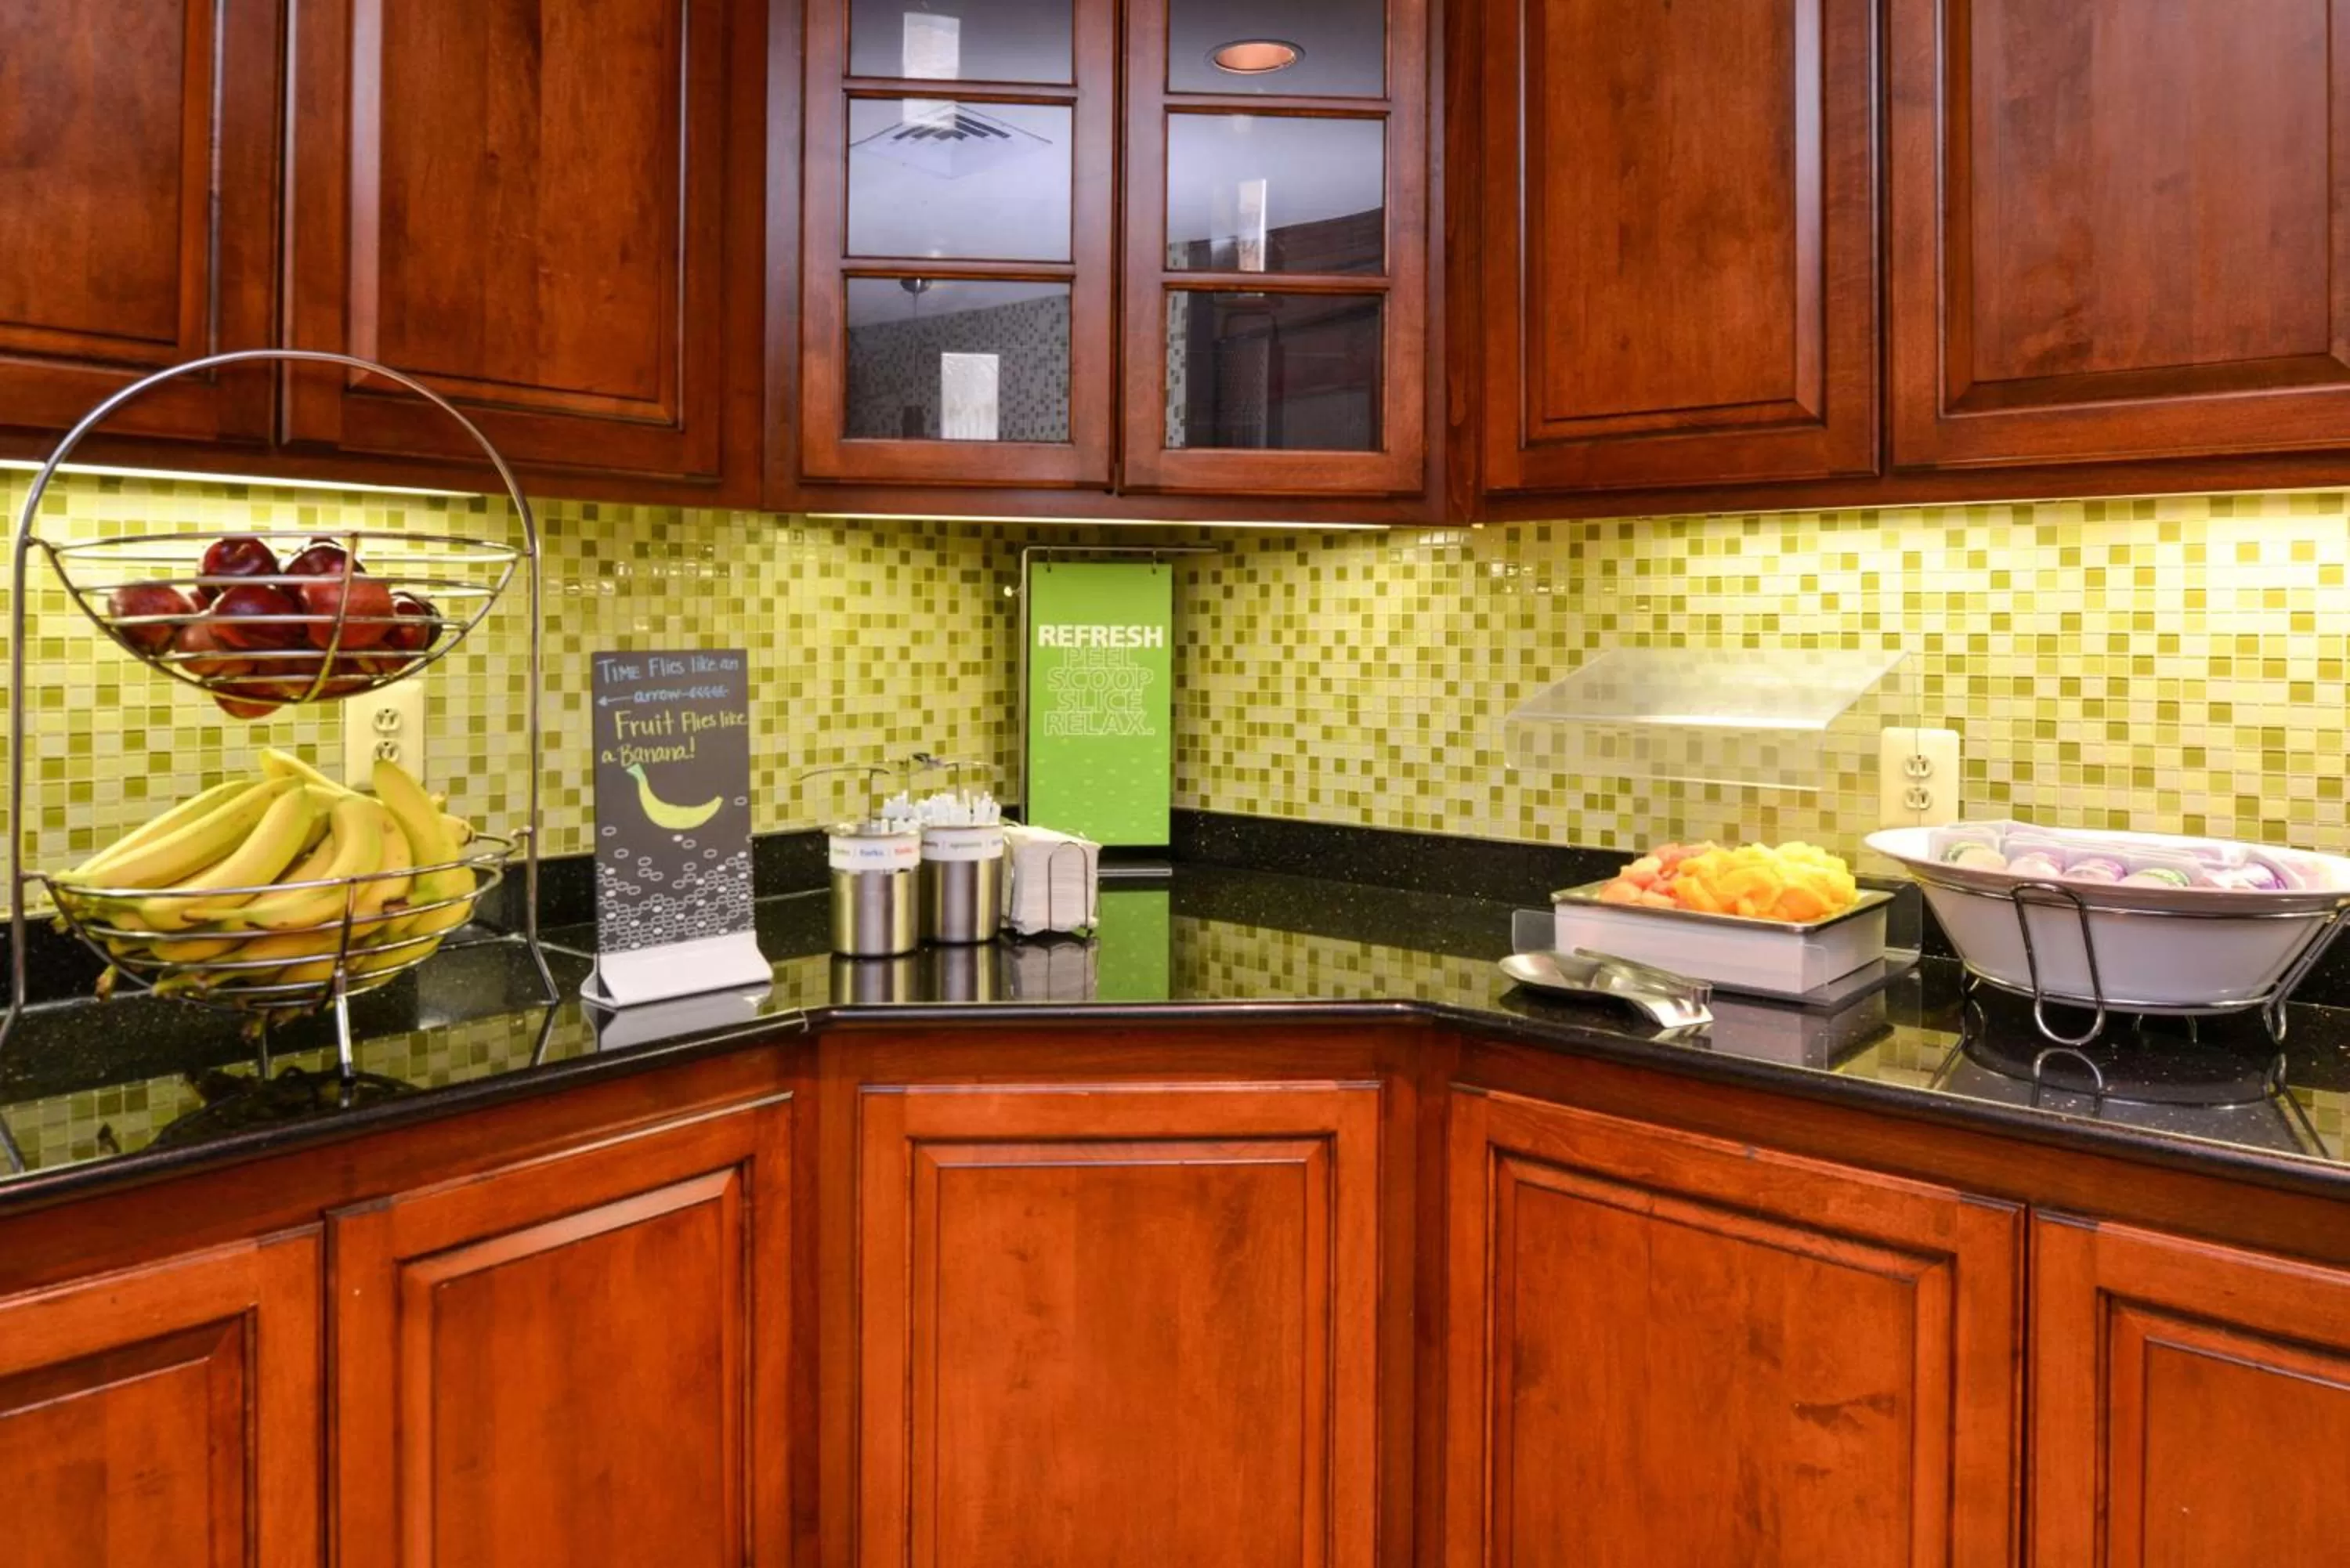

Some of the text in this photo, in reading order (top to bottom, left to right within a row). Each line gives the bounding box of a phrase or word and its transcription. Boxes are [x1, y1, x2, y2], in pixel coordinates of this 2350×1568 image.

[1039, 626, 1163, 648] REFRESH
[648, 656, 685, 677] Flies
[691, 655, 718, 674] like
[720, 658, 739, 671] an
[1064, 647, 1133, 668] PEEL
[1047, 667, 1153, 690] SCOOP
[1058, 689, 1144, 713] SLICE
[615, 710, 747, 740] Fruit Flies like
[1044, 711, 1155, 735] RELAX.
[601, 736, 695, 767] a Banana!
